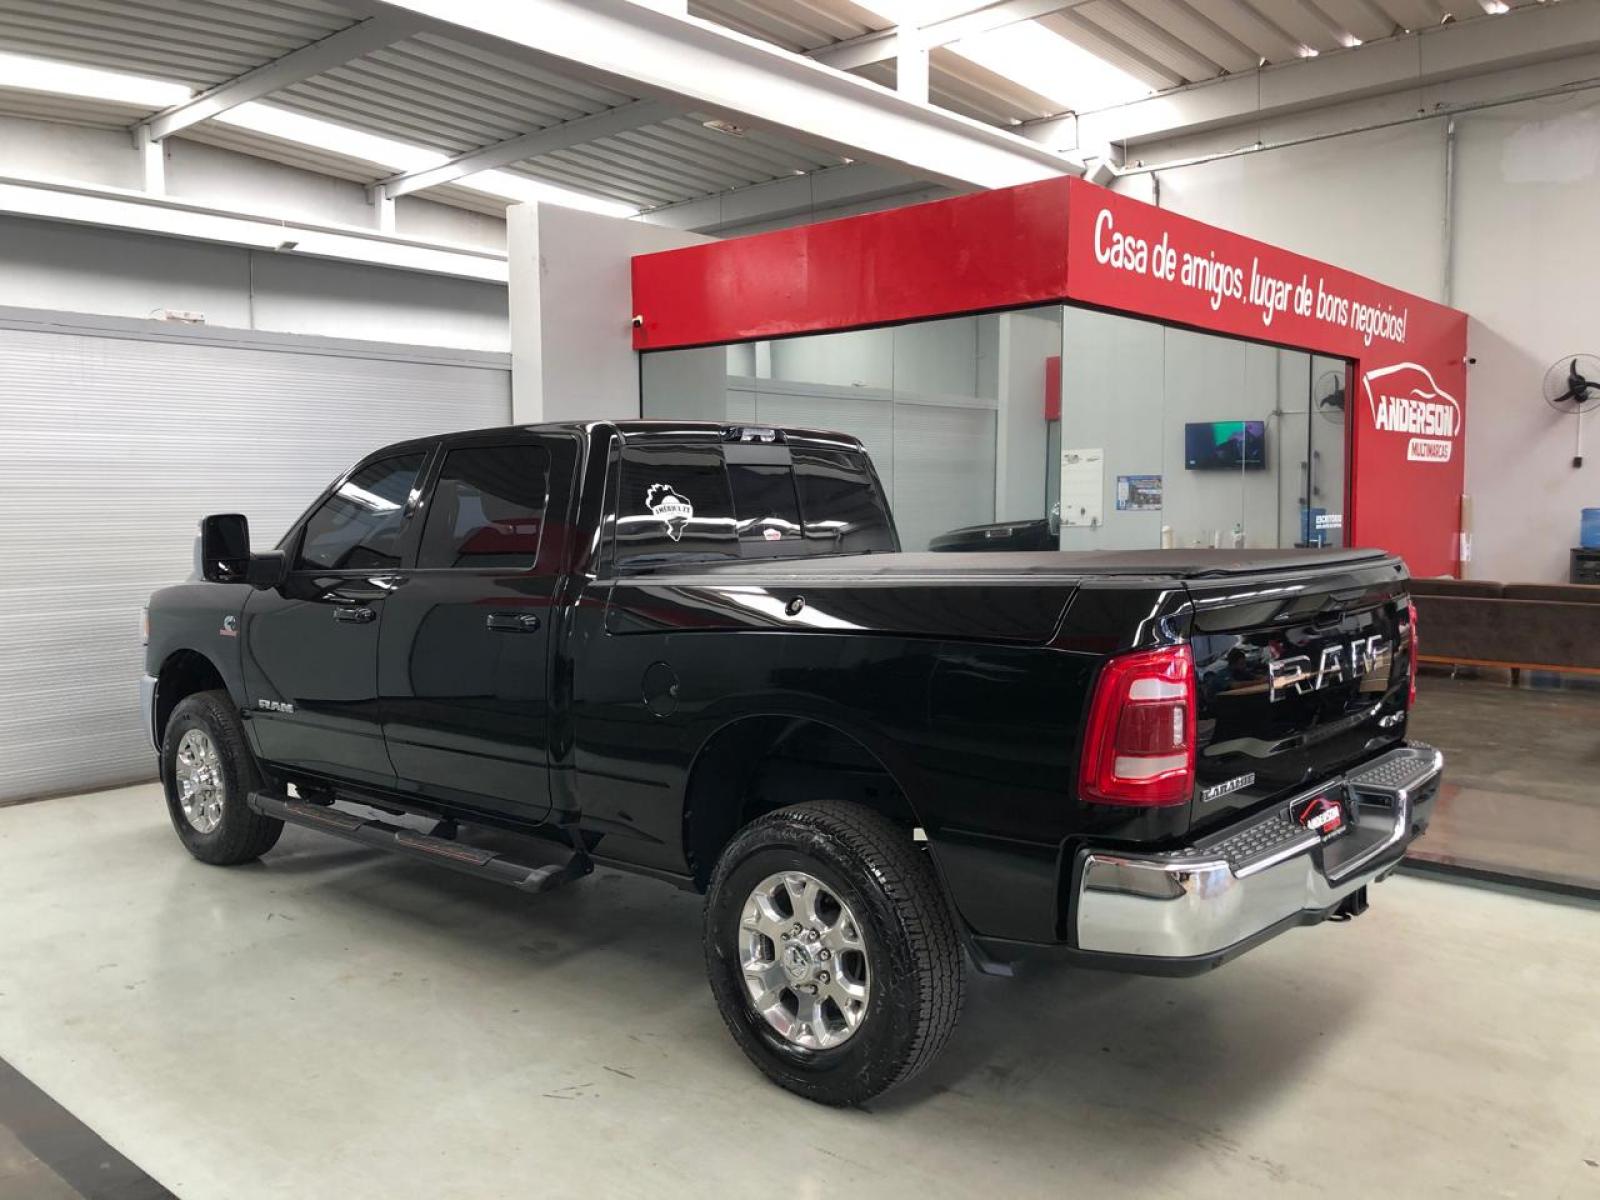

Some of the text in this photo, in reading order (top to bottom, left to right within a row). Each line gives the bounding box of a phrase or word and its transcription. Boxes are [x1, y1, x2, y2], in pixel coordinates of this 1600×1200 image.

[1095, 208, 1408, 347] Casa de amigos, lugar de bons negócios!
[1375, 395, 1453, 437] ANDERSON
[1411, 442, 1449, 458] MULTIMARCAS
[1269, 634, 1393, 703] RAM
[258, 699, 294, 713] RAM
